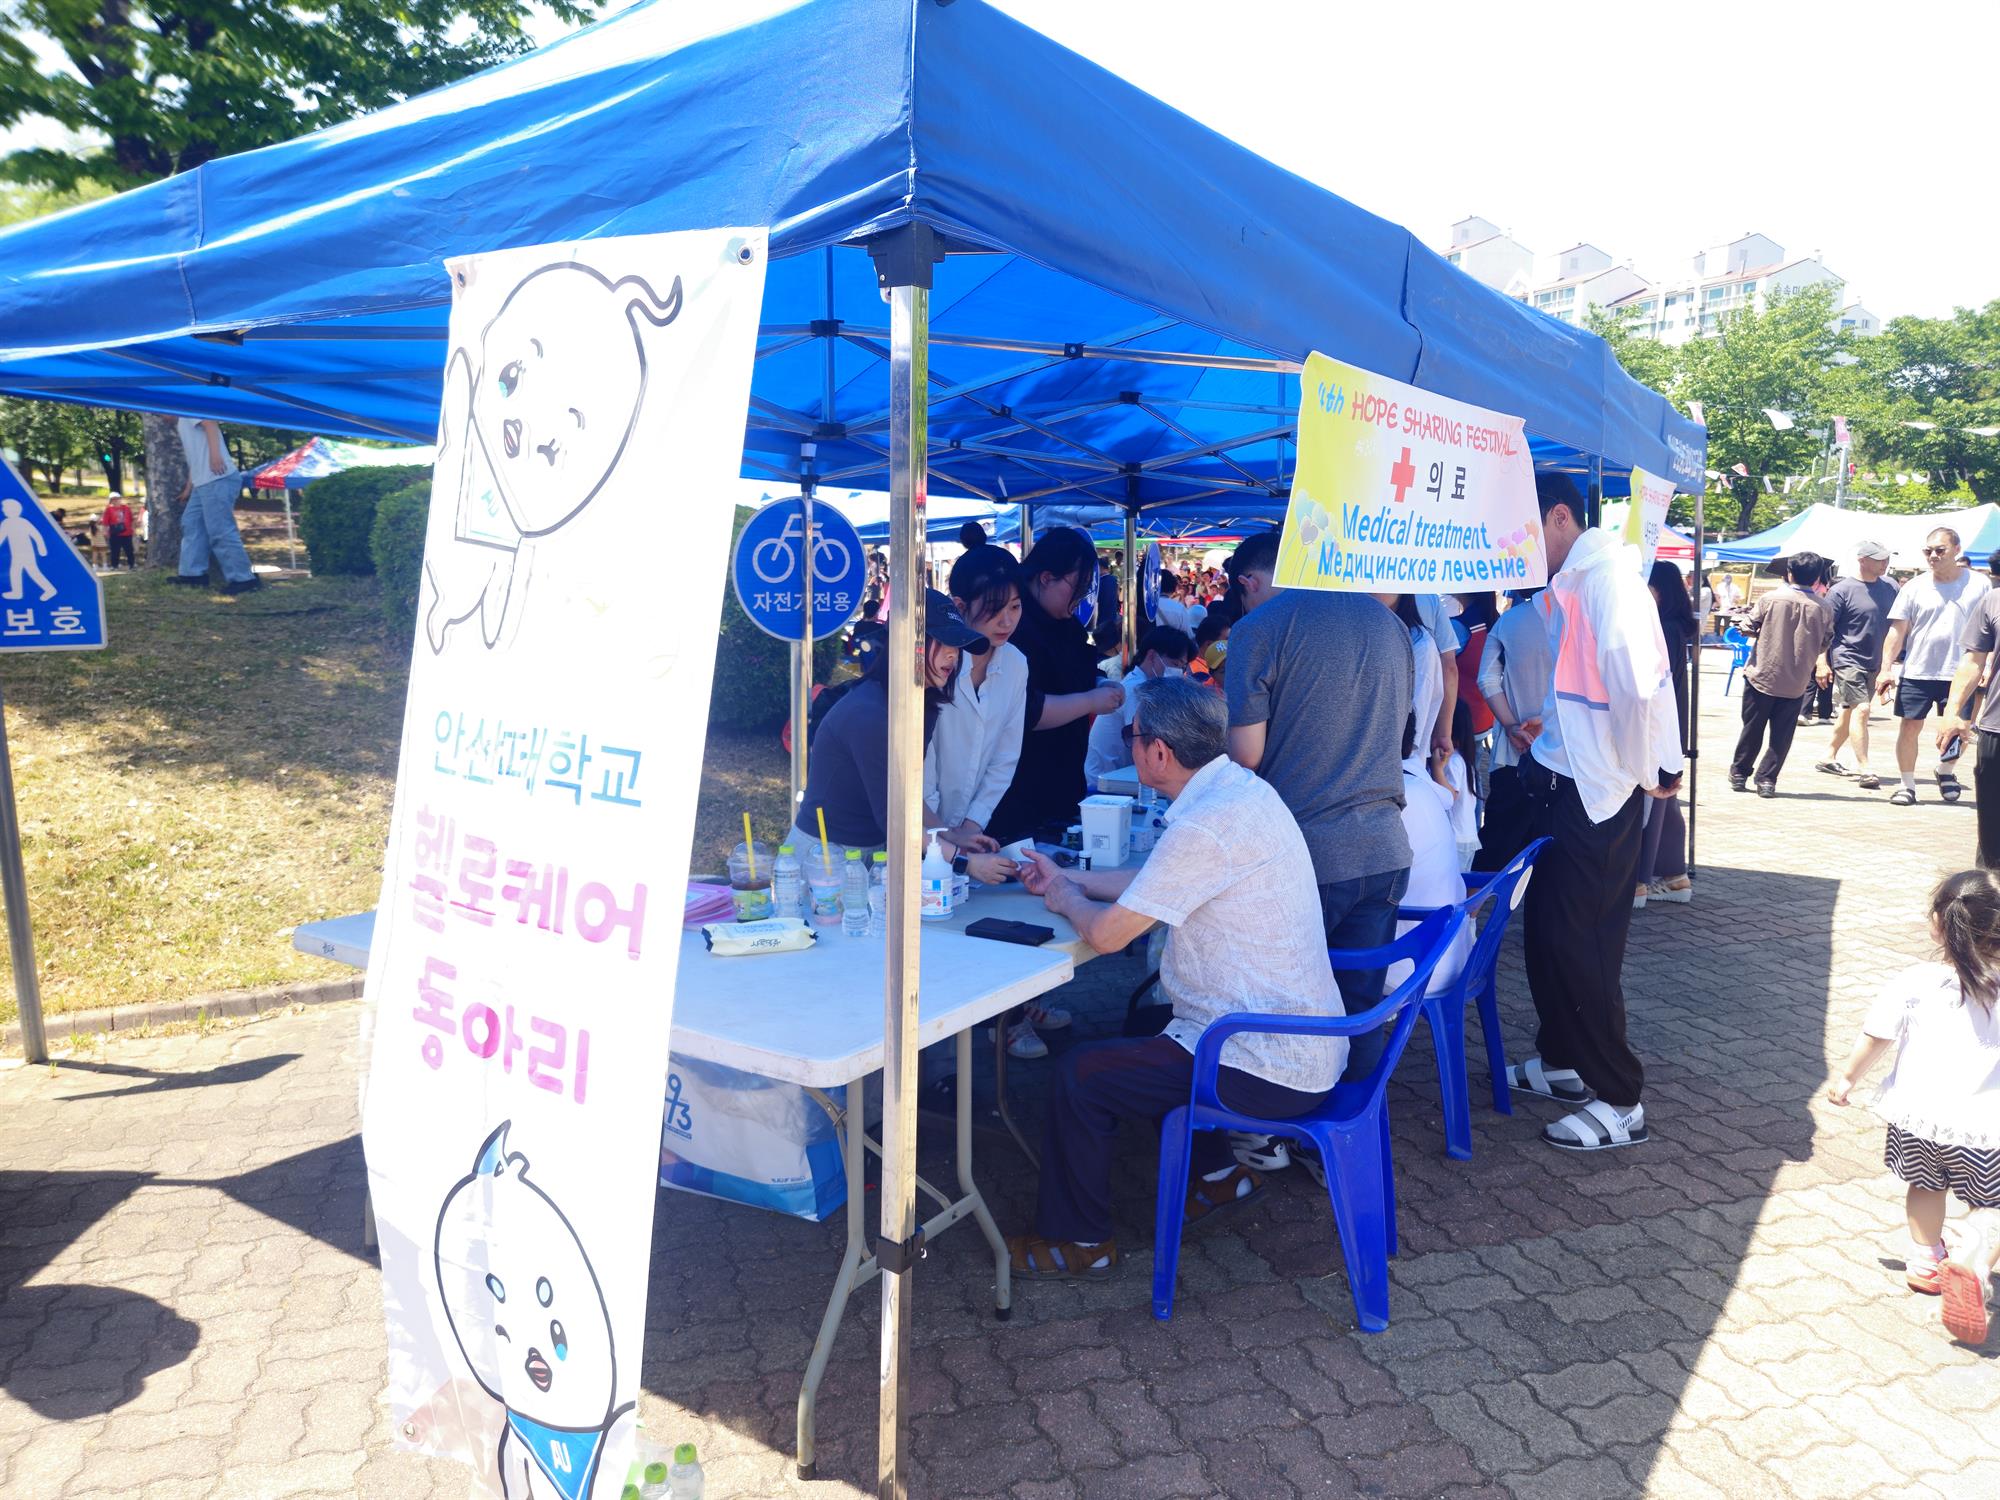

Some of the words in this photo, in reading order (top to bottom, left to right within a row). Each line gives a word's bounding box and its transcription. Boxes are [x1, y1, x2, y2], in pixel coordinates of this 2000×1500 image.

[1351, 390, 1398, 429] HOPE
[1402, 406, 1462, 448] SHARING
[1466, 425, 1518, 457] FESTIVAL
[1426, 461, 1466, 502] 의료
[1343, 502, 1414, 546] Medical
[1414, 515, 1492, 550] treatment
[1317, 541, 1437, 584] Медицинское
[1441, 556, 1526, 582] лечение
[3, 606, 86, 636] 보호
[434, 710, 642, 808] 안산대학교
[408, 803, 648, 961] 헬로케어
[412, 955, 591, 1106] 동아리
